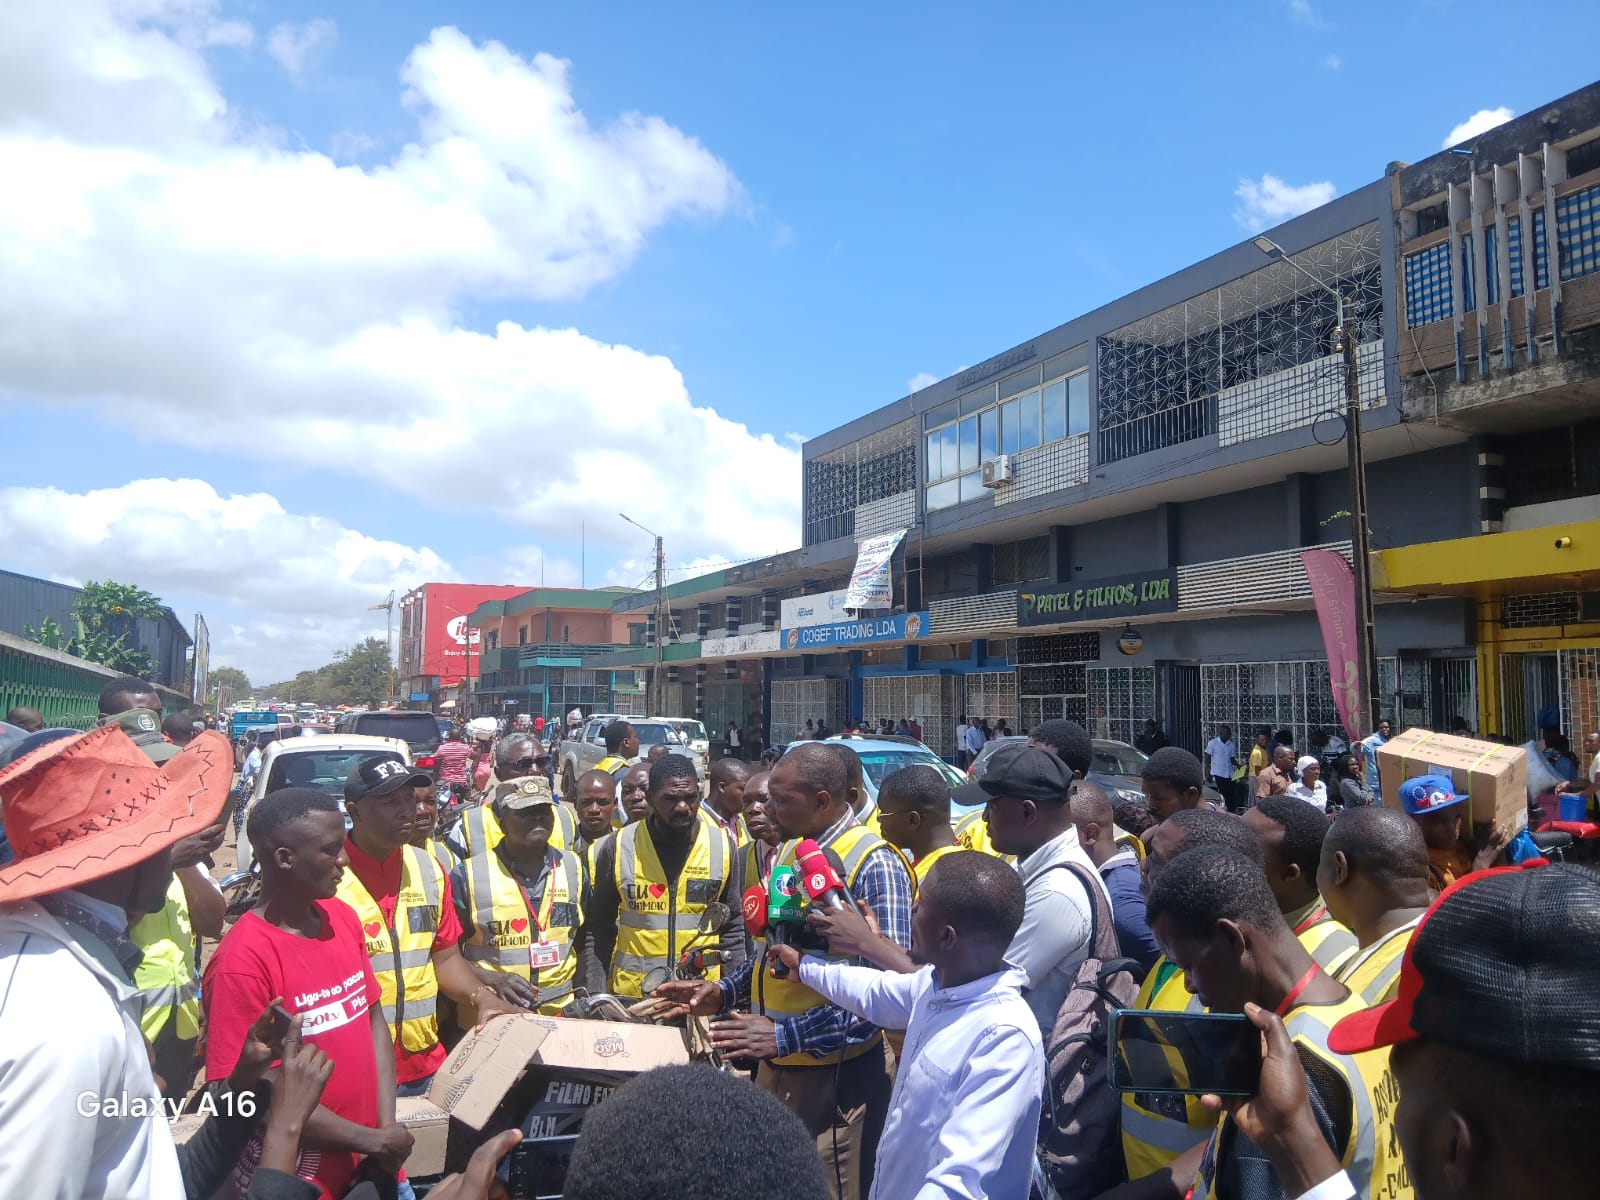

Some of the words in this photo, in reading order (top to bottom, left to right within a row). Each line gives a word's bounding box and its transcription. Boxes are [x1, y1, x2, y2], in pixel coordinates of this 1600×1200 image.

[1036, 592, 1071, 614] PATEL
[1073, 589, 1084, 611] &
[1085, 583, 1138, 606] FILHOS,
[1141, 578, 1170, 601] LDA
[802, 627, 832, 644] COGEF
[834, 623, 874, 641] TRADING
[876, 620, 896, 636] LDA
[374, 760, 410, 779] FBI
[331, 984, 343, 996] ao
